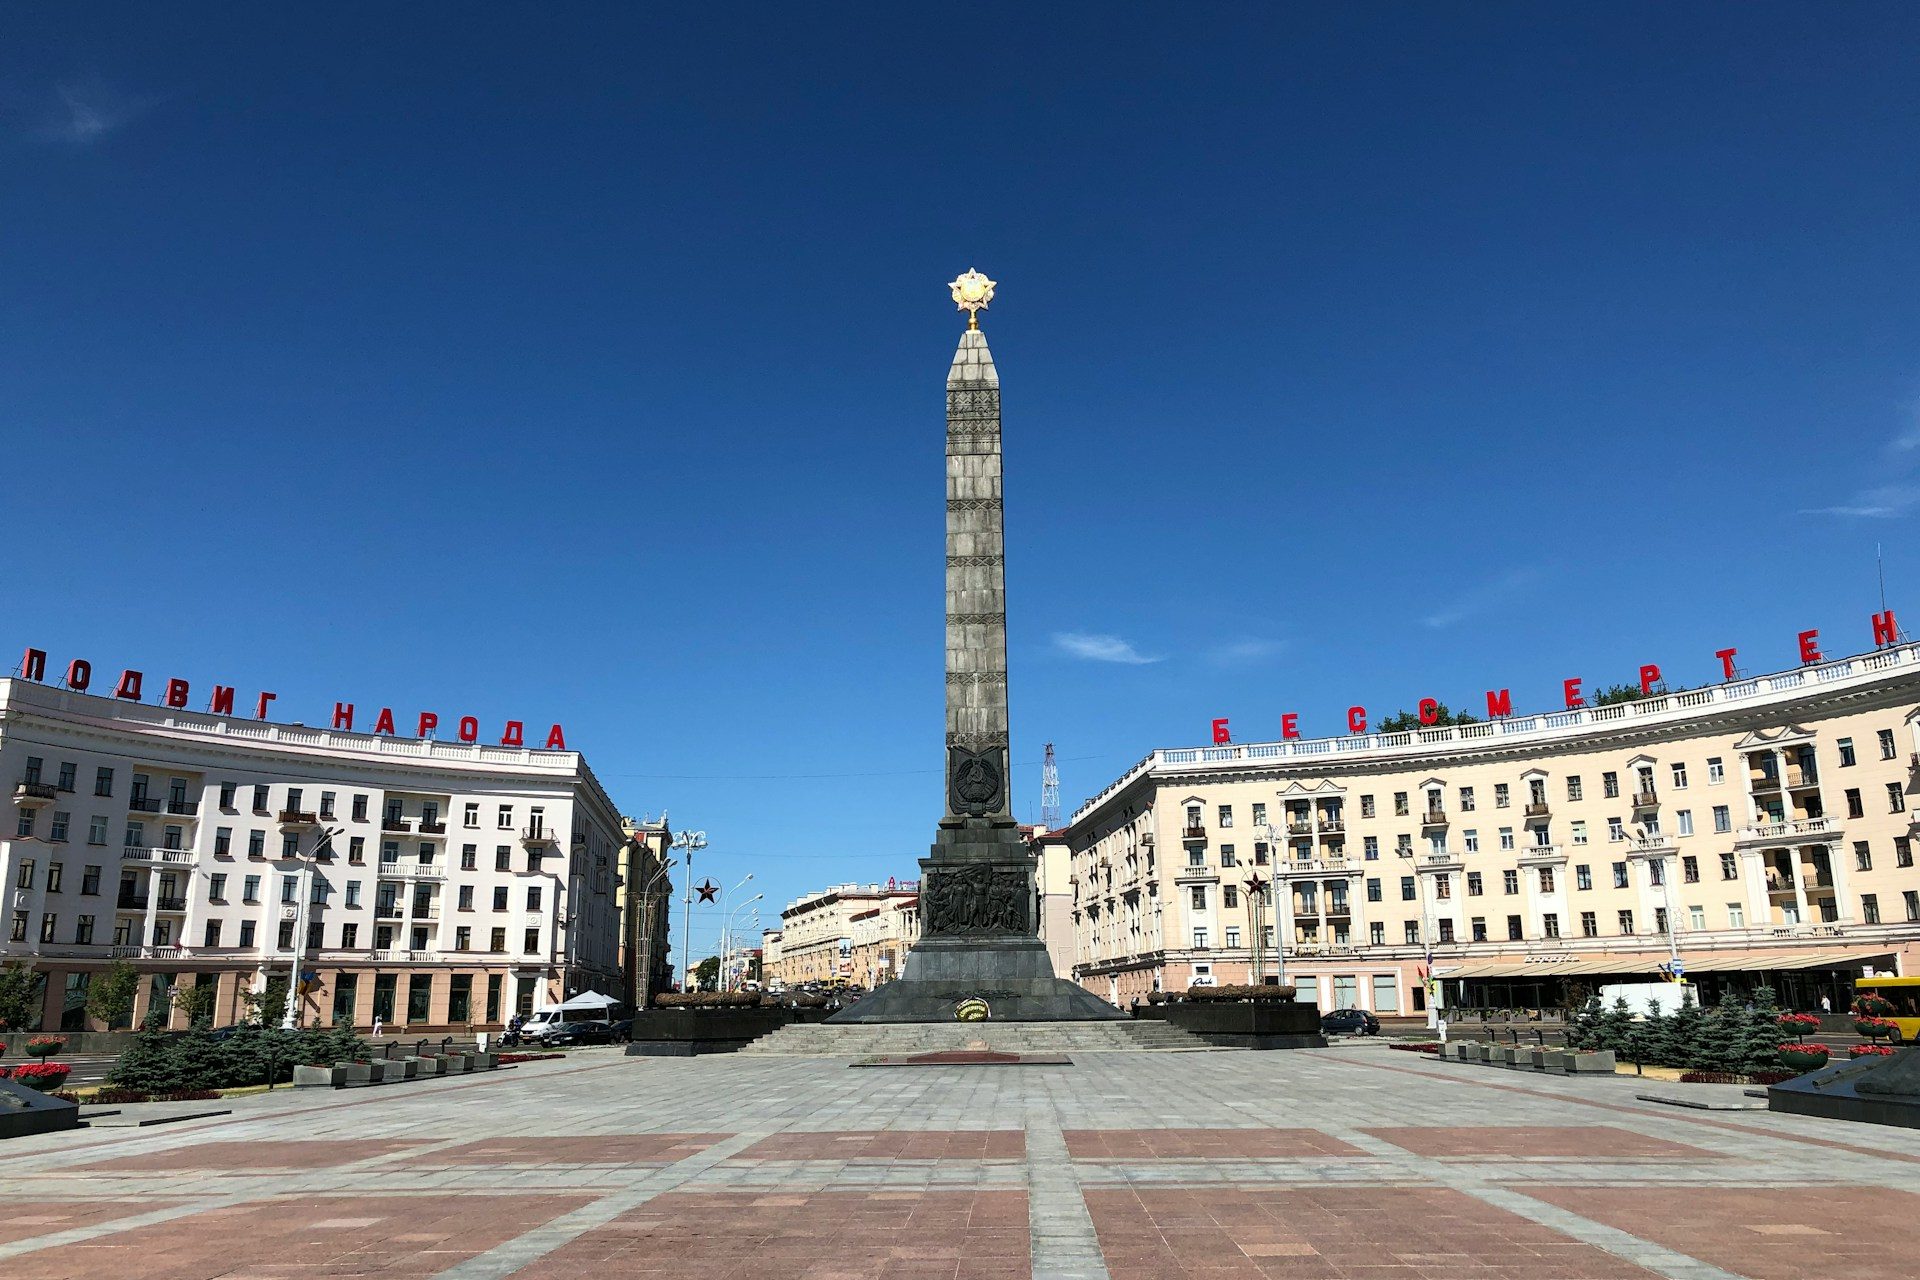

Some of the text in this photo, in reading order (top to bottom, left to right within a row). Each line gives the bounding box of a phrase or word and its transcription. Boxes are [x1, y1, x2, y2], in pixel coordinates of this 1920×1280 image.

[23, 648, 566, 749] ПОДВИГ НАРОДА
[1212, 611, 1897, 745] БЕССМЕРТЕН
